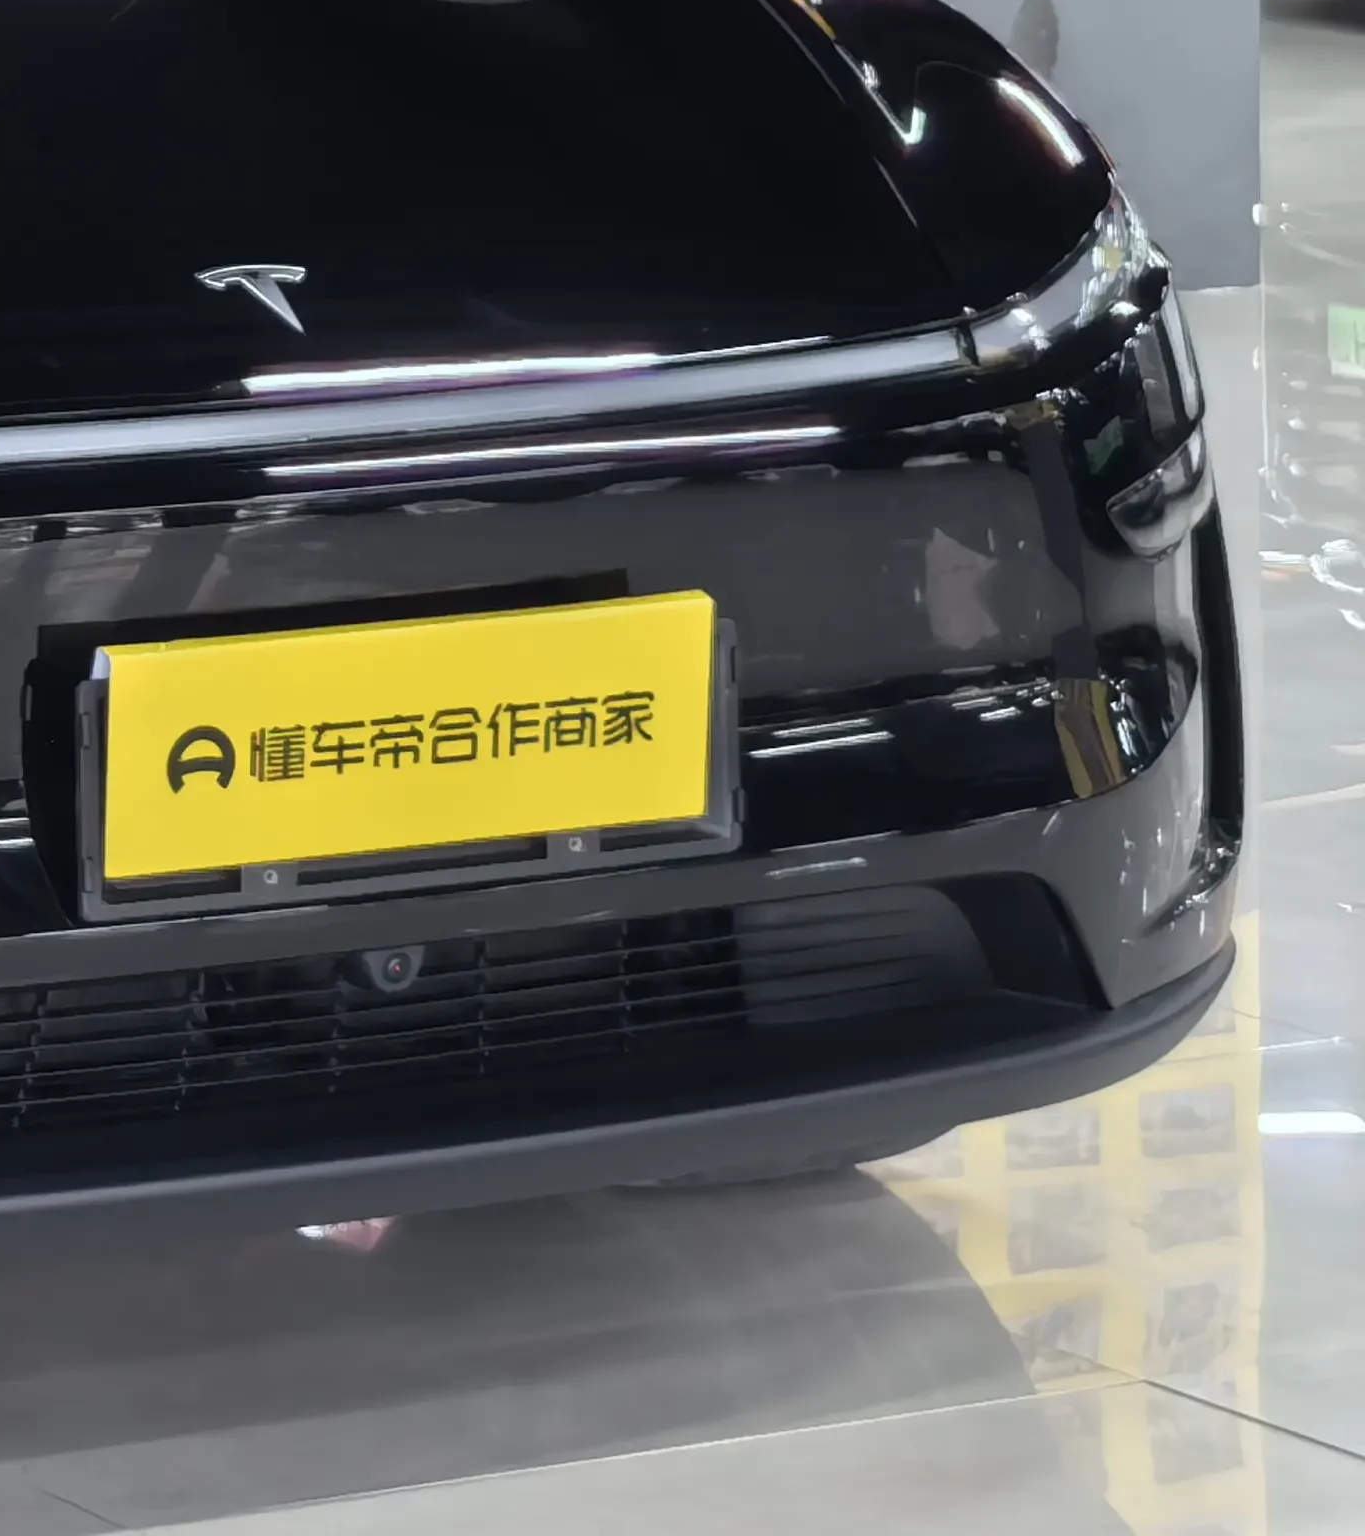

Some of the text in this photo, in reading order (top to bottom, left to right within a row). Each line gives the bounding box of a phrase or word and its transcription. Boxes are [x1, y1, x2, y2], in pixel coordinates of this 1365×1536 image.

[249, 690, 656, 782] 懂车帝合作商家
